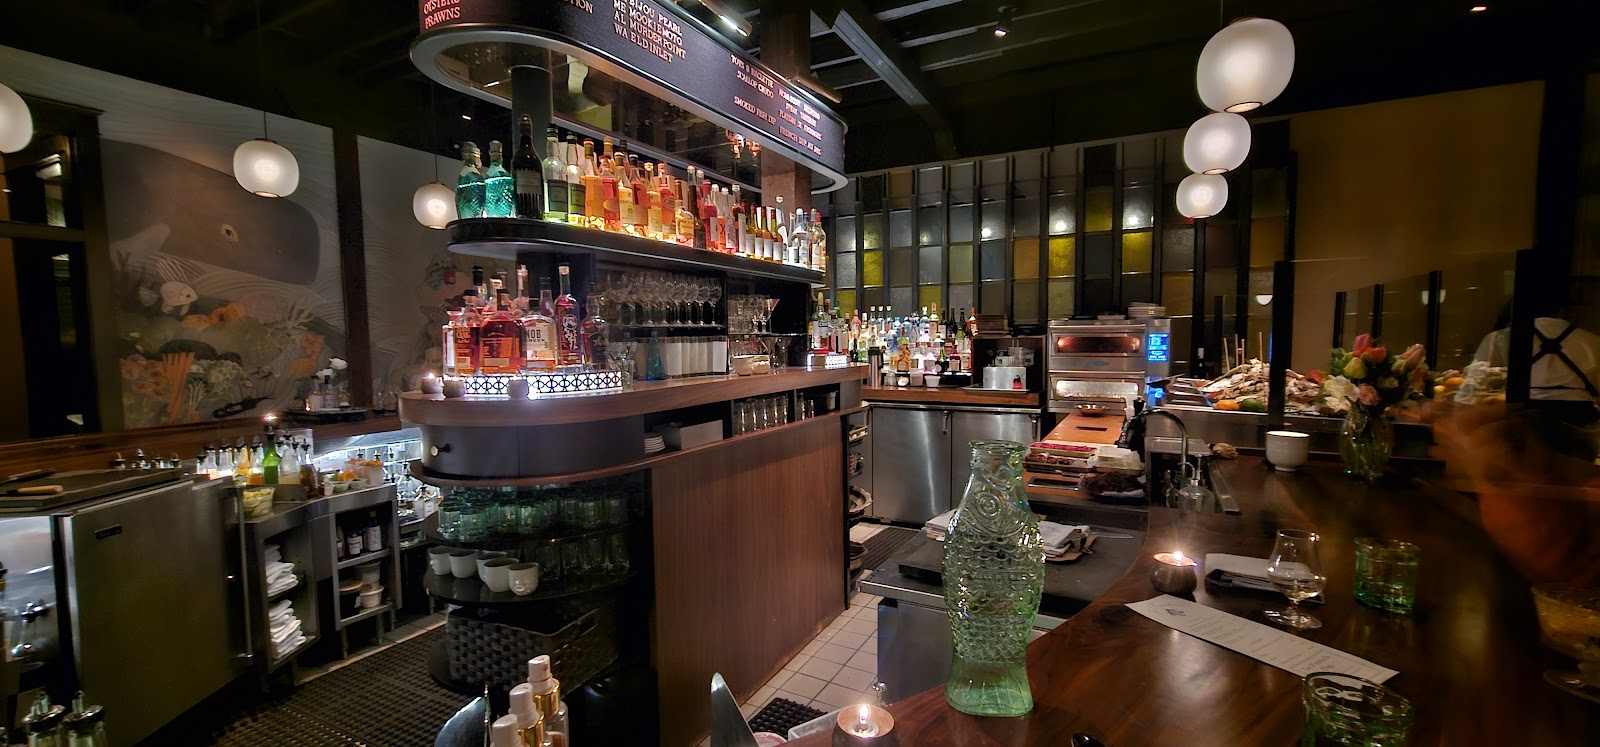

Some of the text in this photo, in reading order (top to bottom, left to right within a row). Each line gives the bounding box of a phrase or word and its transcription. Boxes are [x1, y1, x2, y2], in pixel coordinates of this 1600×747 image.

[423, 0, 460, 14] OYSTE
[613, 0, 626, 14] ME
[424, 6, 460, 29] PRAWNS
[614, 11, 626, 25] AL
[658, 13, 682, 36] PEARL
[614, 23, 628, 39] WA
